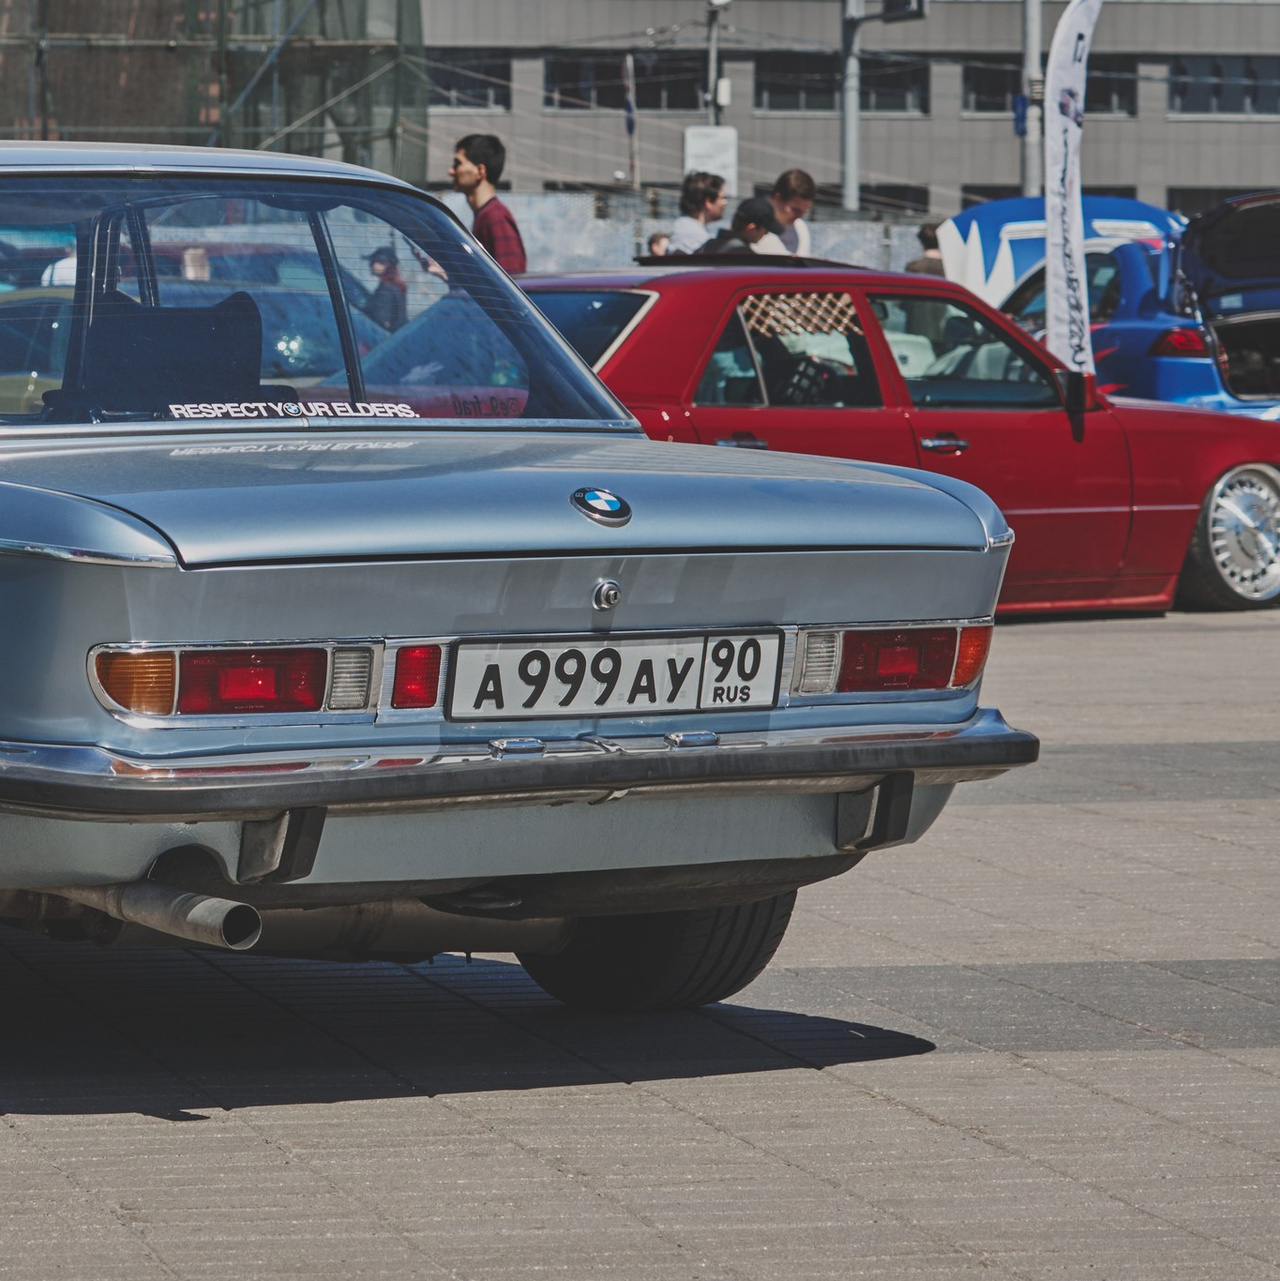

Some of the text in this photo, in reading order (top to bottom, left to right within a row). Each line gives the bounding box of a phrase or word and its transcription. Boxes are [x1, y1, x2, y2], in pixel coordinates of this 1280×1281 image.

[169, 402, 268, 419] RESPECT
[710, 637, 762, 683] 90
[711, 684, 752, 704] RUS
